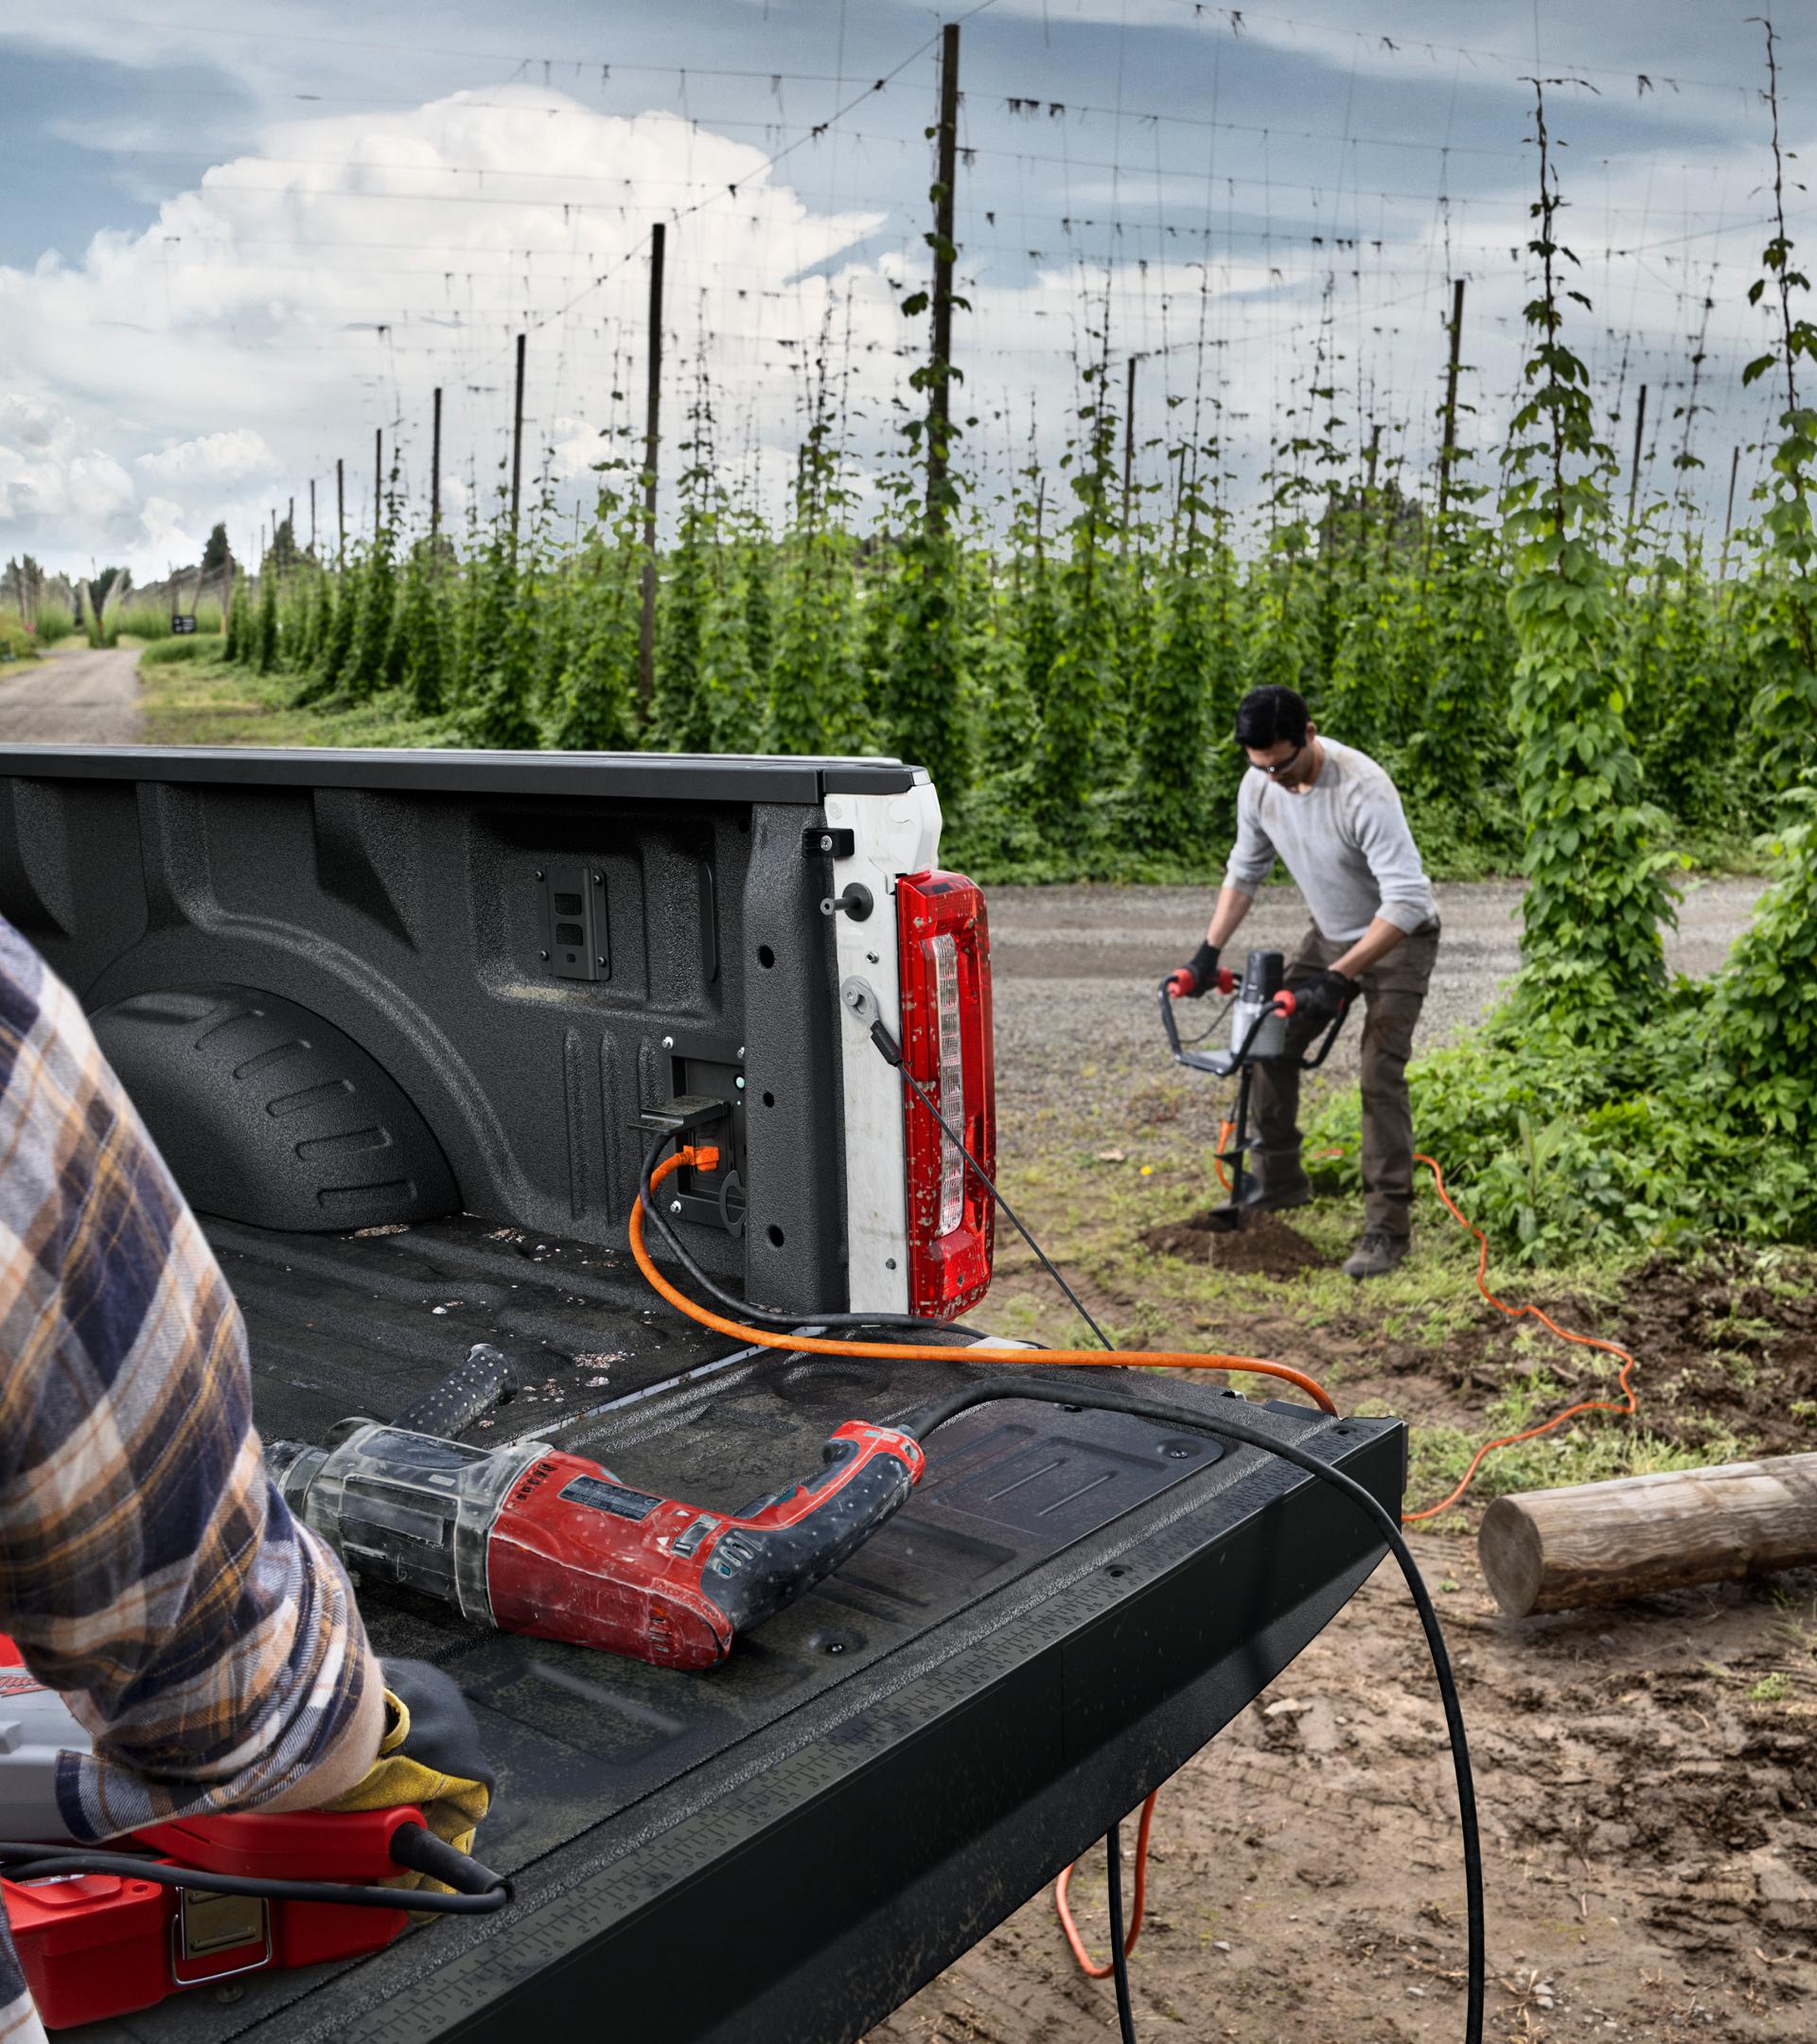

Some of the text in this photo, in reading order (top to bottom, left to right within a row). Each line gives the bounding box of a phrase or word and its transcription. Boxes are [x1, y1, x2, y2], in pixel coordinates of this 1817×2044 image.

[417, 2015, 446, 2034] 23
[460, 1989, 488, 2008] 24
[500, 1963, 527, 1982] 25
[576, 1915, 601, 1933] 27
[682, 1851, 706, 1868] 30
[778, 1791, 803, 1806] 33
